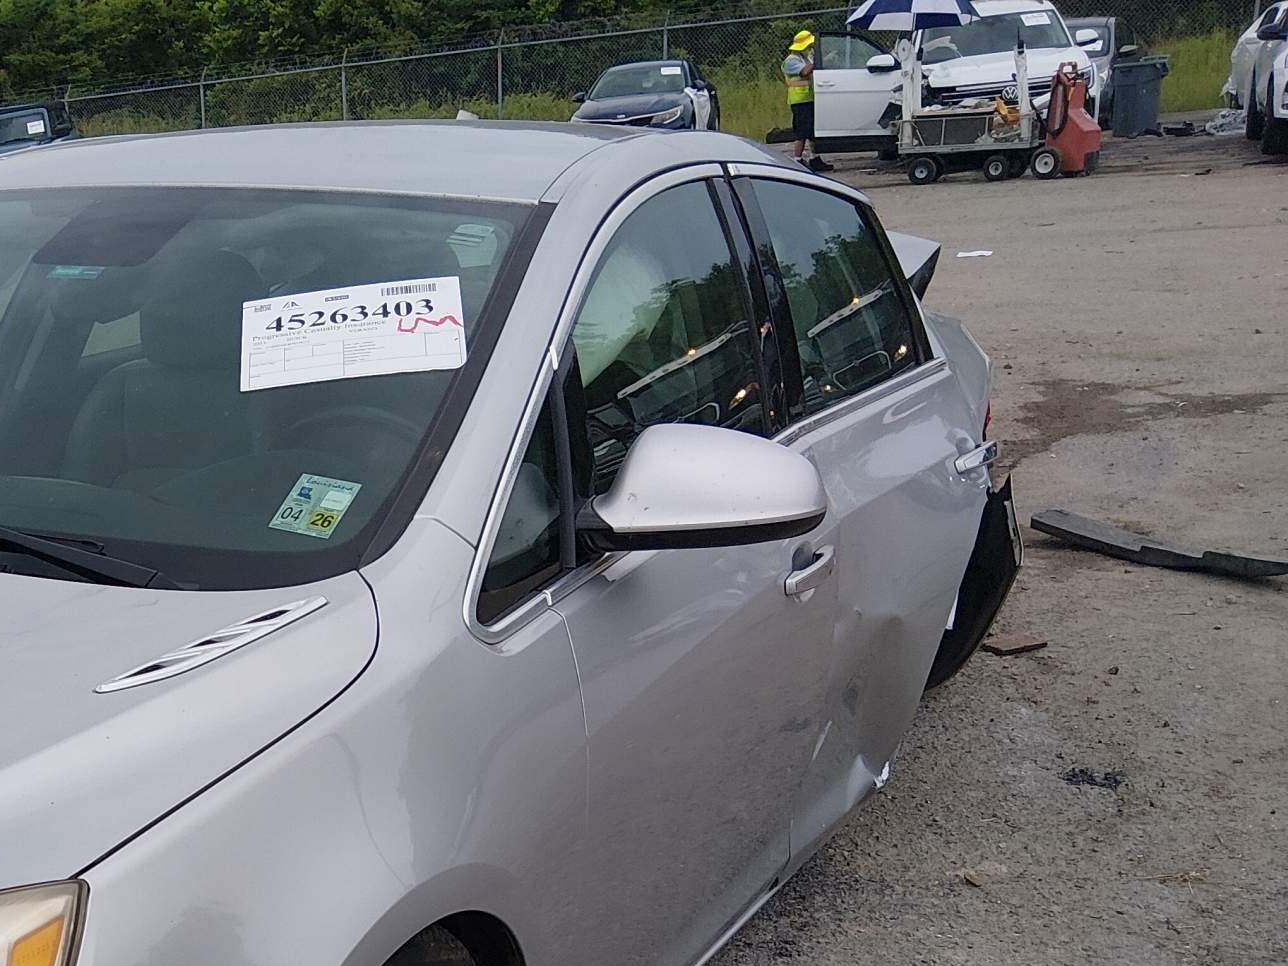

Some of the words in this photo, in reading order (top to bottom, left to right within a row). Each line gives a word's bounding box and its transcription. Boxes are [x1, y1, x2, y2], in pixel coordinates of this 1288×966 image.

[266, 299, 434, 332] 45263403
[253, 329, 302, 342] Progressive
[281, 506, 303, 521] 04
[310, 512, 334, 528] 26
